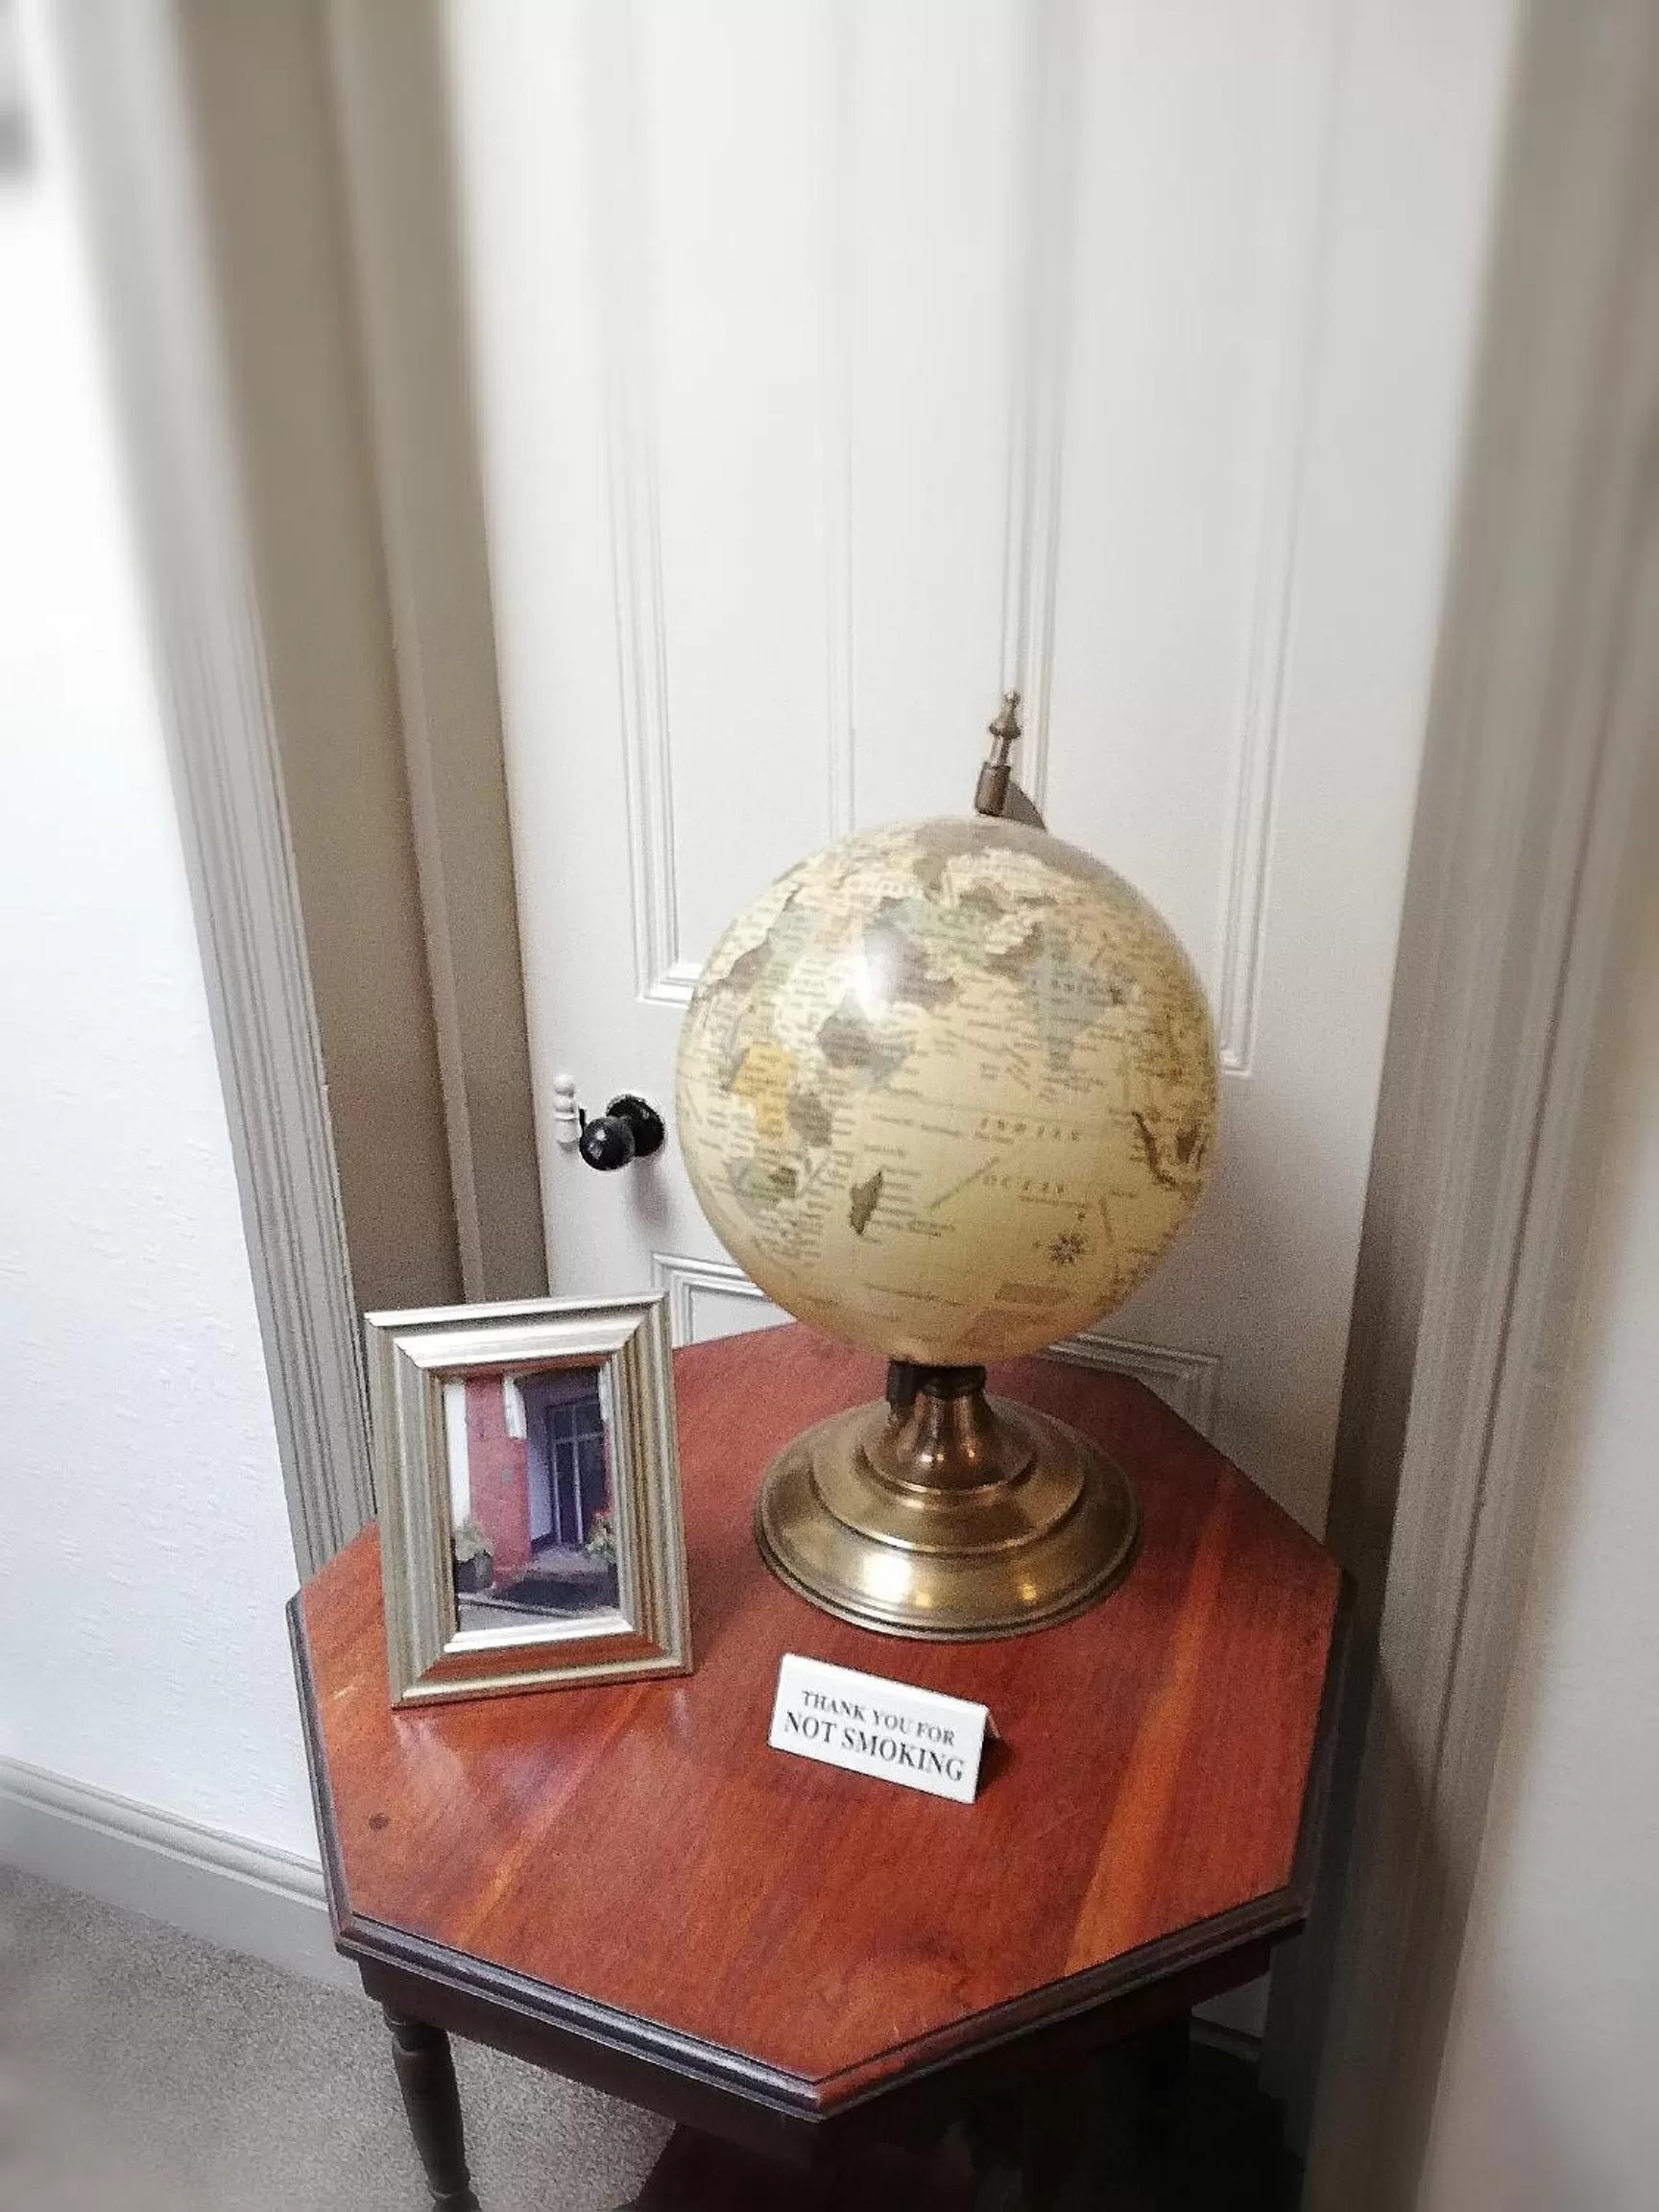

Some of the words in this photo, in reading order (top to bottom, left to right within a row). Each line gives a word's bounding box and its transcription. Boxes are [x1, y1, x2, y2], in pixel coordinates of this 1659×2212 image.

[784, 1711, 837, 1744] NOT
[841, 1727, 965, 1782] SMOKING
[802, 1690, 866, 1722] THANK
[873, 1710, 912, 1735] YOU
[917, 1721, 955, 1746] FOR
